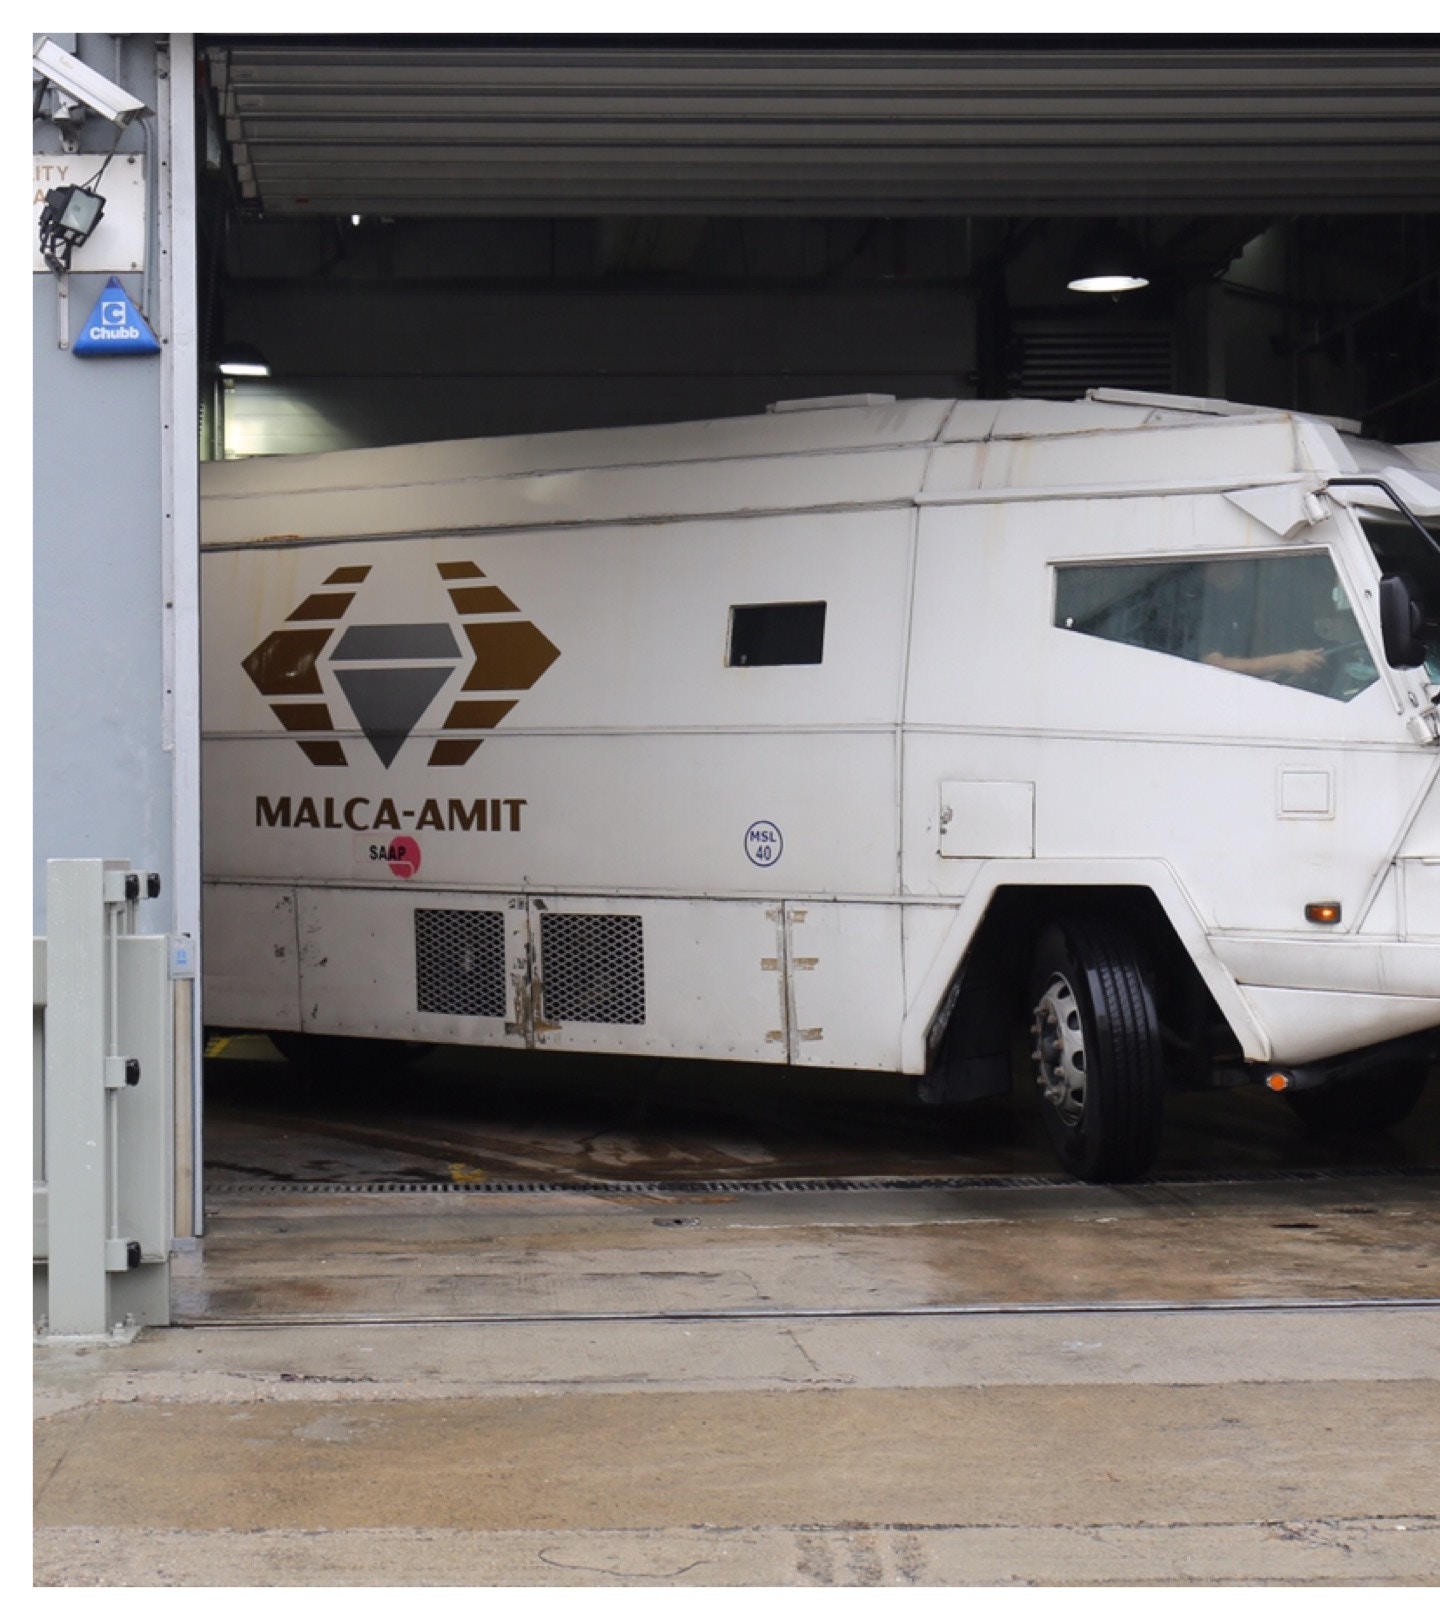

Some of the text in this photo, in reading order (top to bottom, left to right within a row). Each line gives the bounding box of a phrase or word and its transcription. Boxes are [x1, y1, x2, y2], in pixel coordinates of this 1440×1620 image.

[33, 165, 69, 181] ITY
[89, 326, 140, 340] Chubb
[255, 796, 527, 832] MALCA-AMIT
[750, 830, 777, 842] MSL
[369, 844, 407, 861] SAAP
[756, 845, 772, 861] 40
